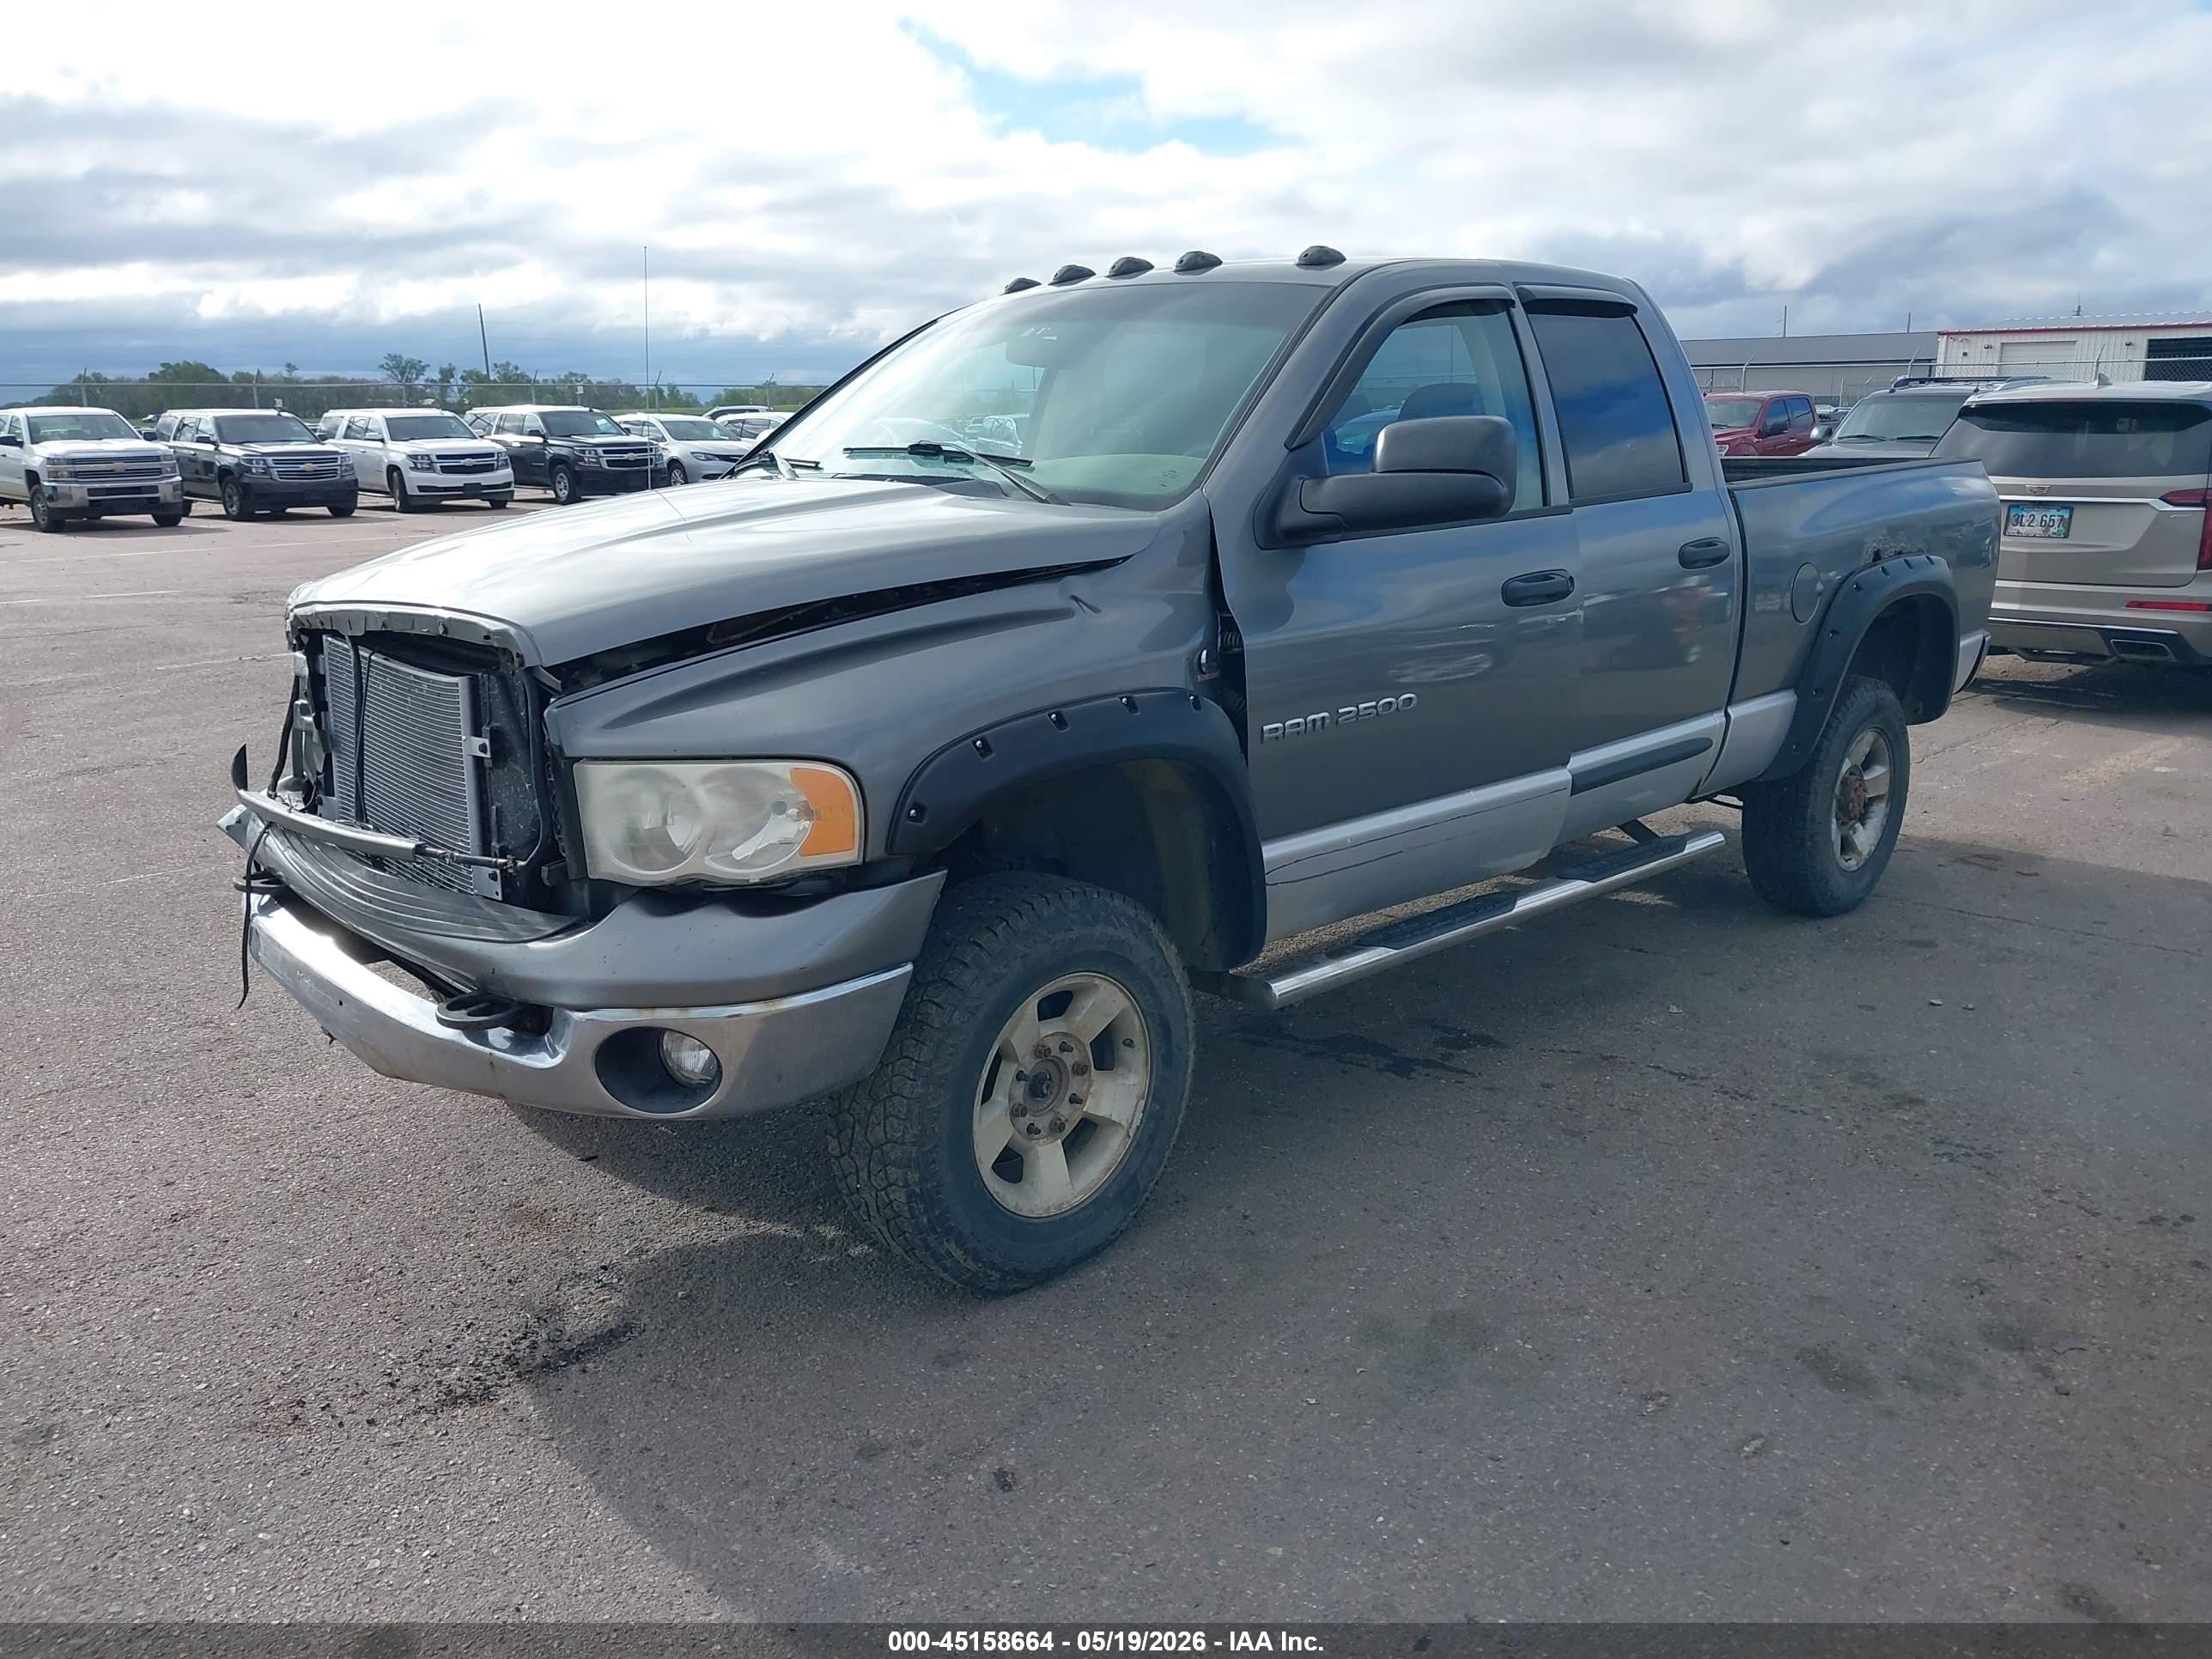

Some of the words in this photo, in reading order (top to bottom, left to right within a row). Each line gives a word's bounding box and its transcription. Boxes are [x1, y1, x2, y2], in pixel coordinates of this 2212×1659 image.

[2012, 514, 2036, 527] 3L2
[2039, 514, 2064, 528] 657
[1261, 712, 1331, 744] RAM
[1336, 693, 1418, 726] 2500
